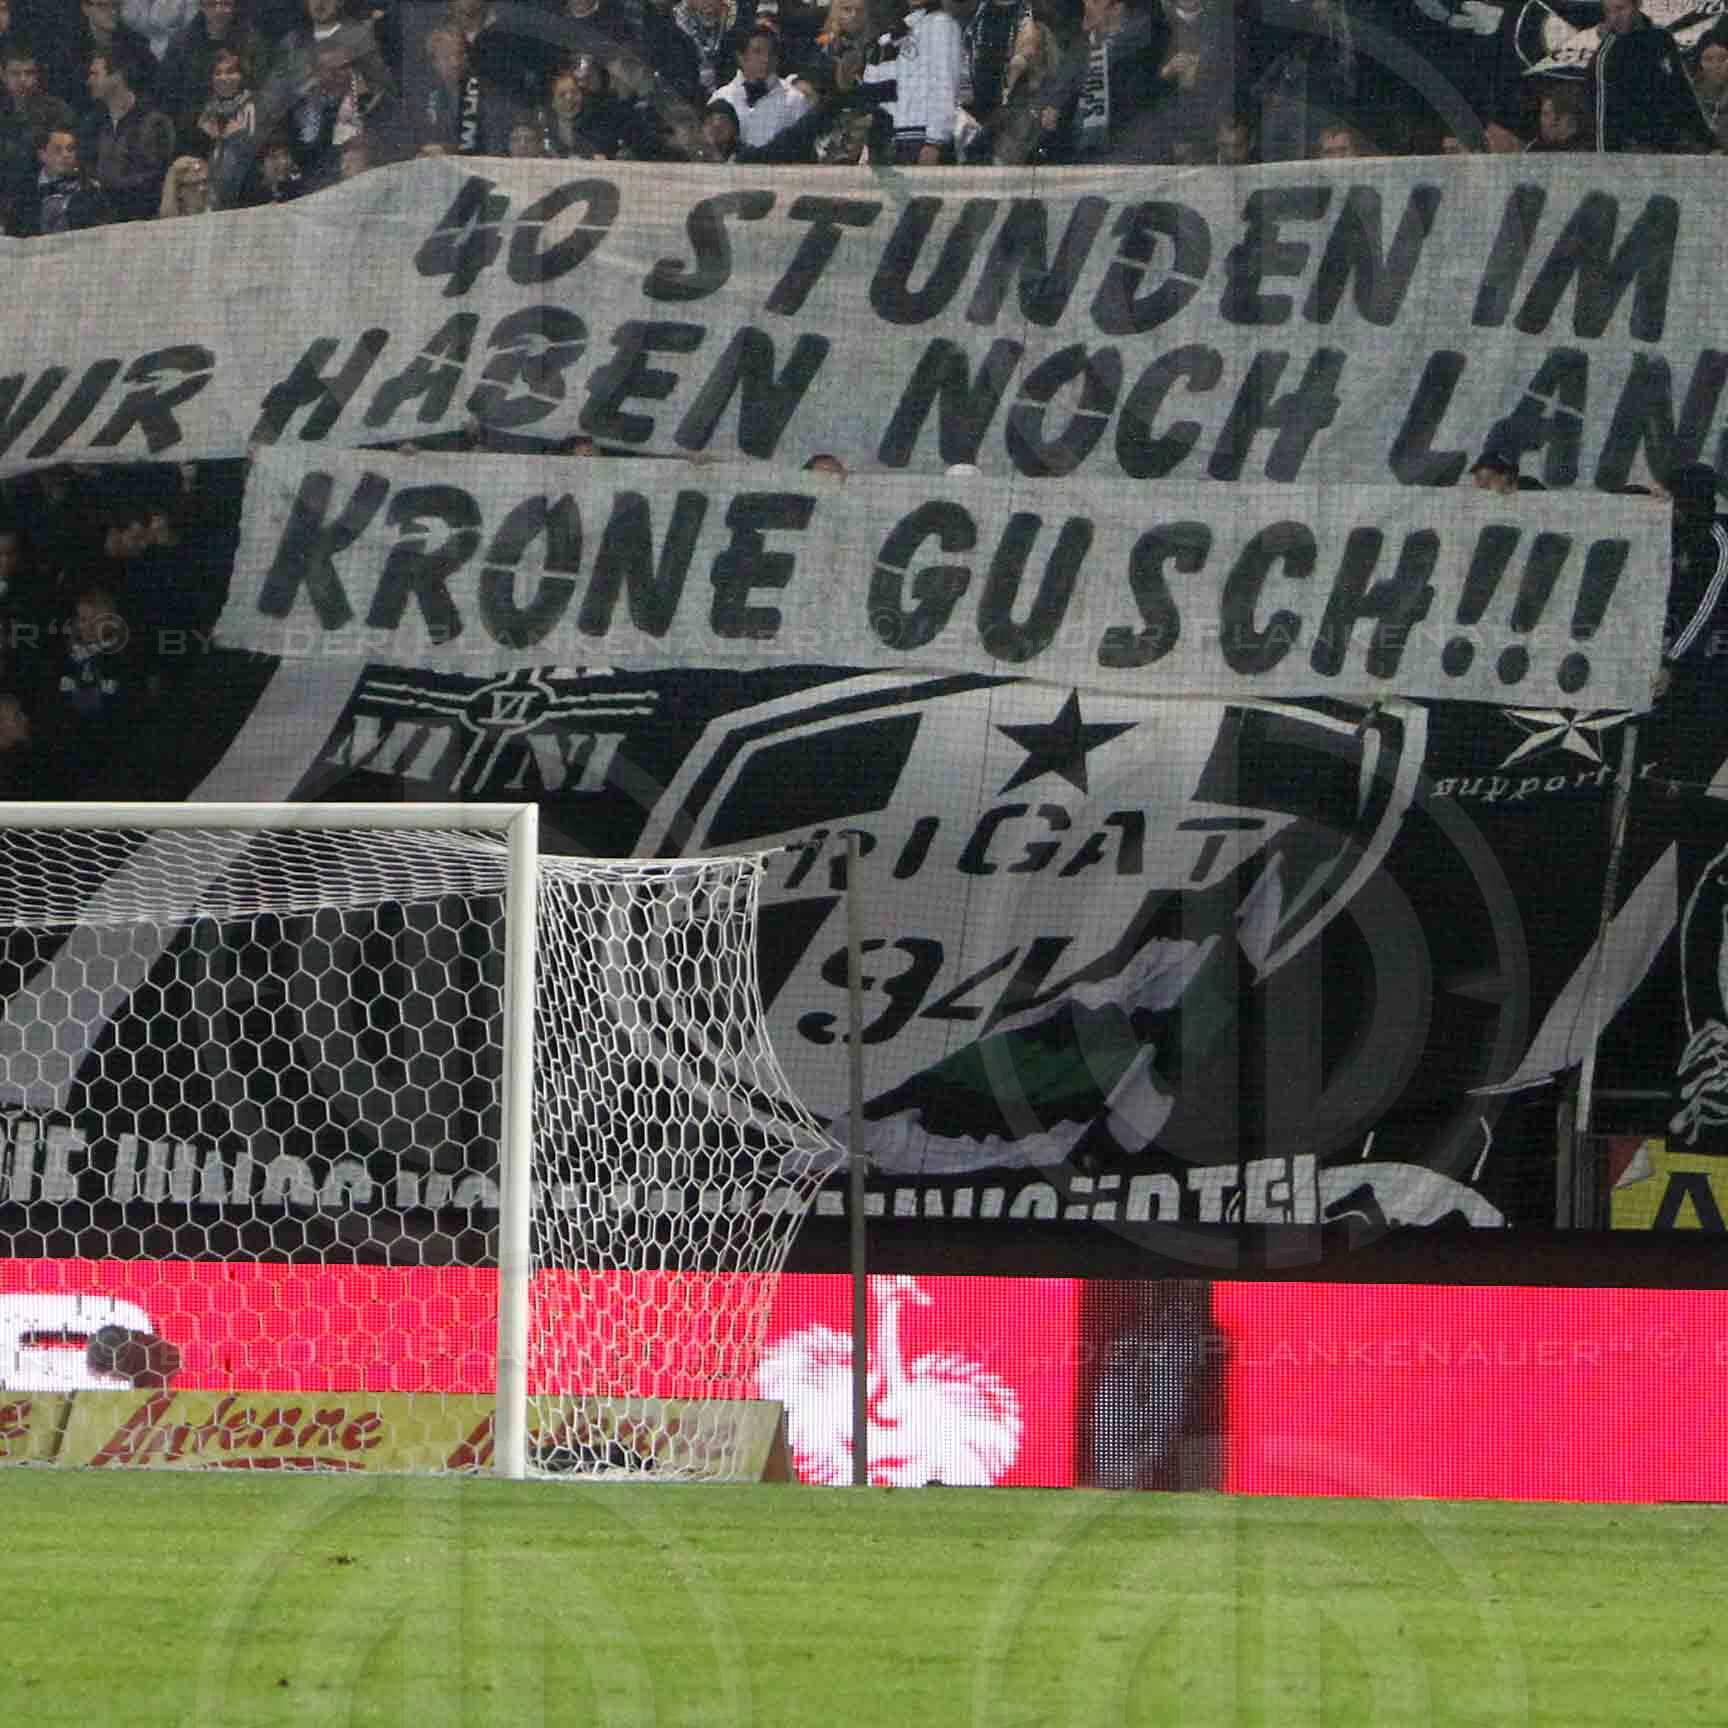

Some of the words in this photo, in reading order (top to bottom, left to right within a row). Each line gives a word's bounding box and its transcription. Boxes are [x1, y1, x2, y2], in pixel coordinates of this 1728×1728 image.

[413, 172, 623, 299] 40
[642, 180, 1442, 335] STUNDEN
[1471, 180, 1681, 344] IM
[251, 302, 833, 462] HABEN
[877, 338, 1346, 484] NOCH
[256, 469, 816, 650] KRONE
[869, 498, 1631, 695] GUSCH!!!
